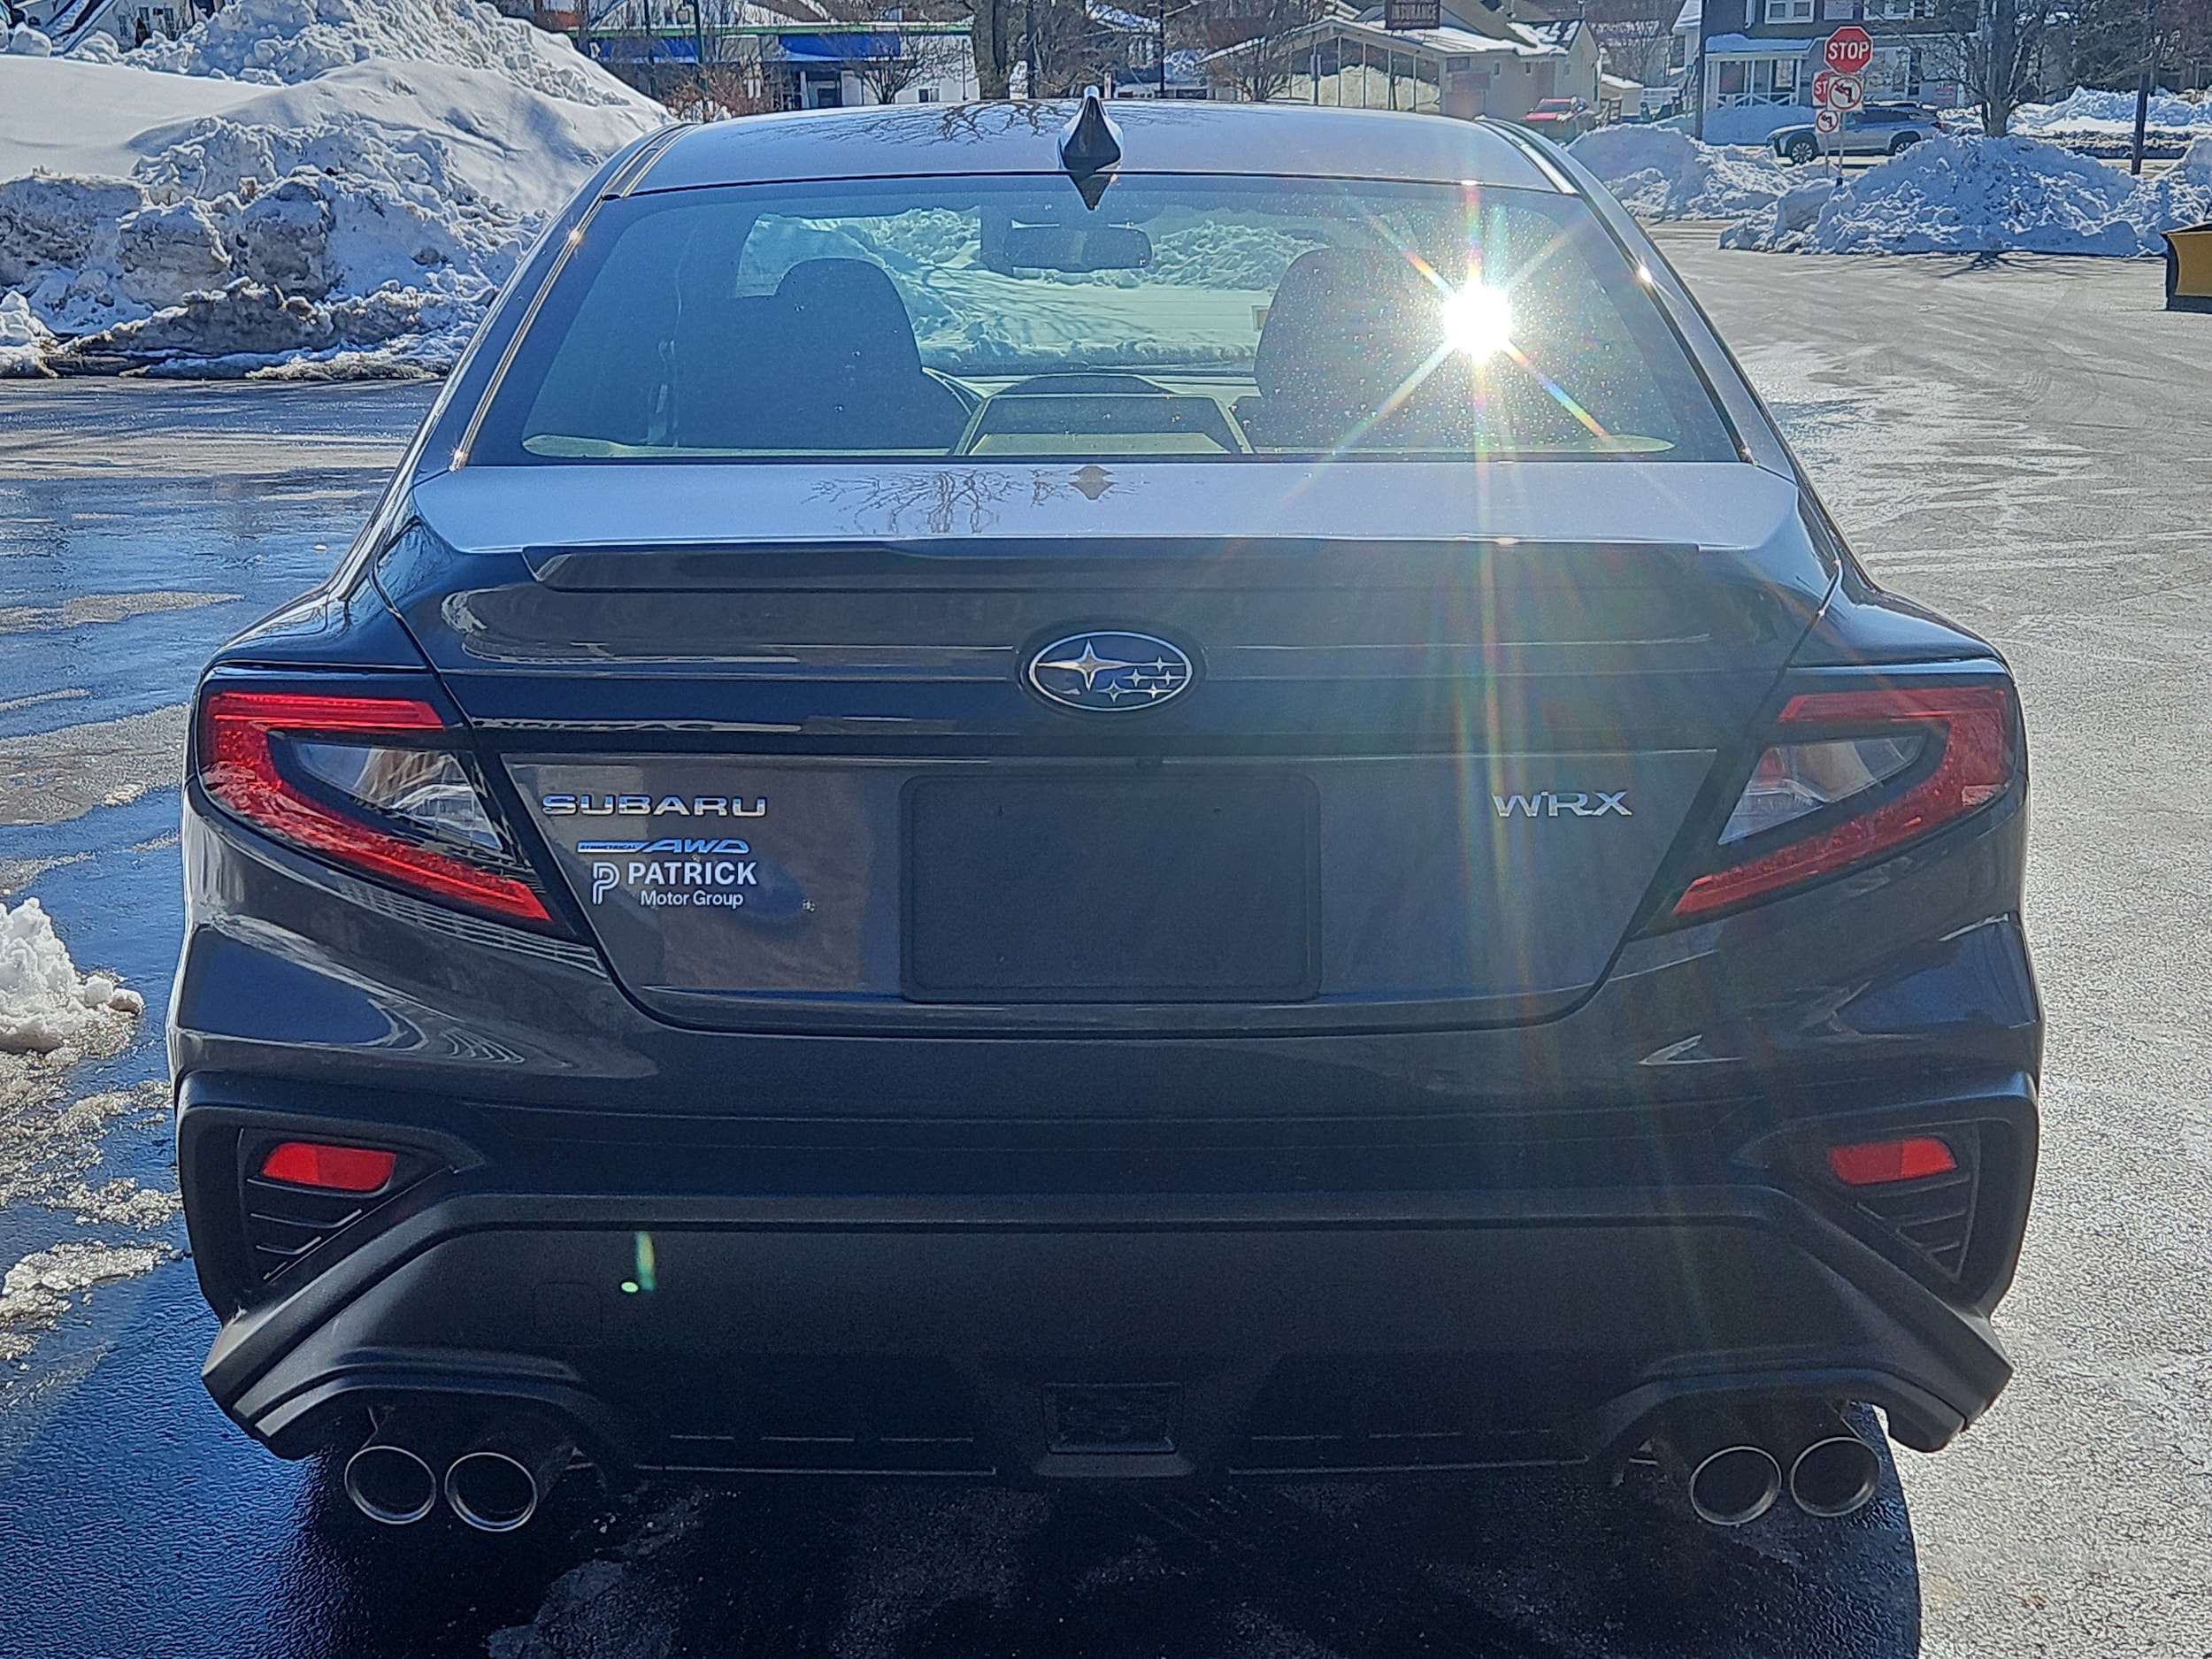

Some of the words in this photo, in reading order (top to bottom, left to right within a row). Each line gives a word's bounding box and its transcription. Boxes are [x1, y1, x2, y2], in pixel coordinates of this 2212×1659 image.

[1828, 42, 1870, 60] STOP
[1815, 81, 1828, 95] ST
[541, 795, 767, 817] SUBARU
[1491, 791, 1633, 817] WRX
[641, 839, 750, 854] AWD
[627, 861, 757, 886] PATRICK
[640, 890, 690, 906] Motor
[693, 890, 744, 910] Group
